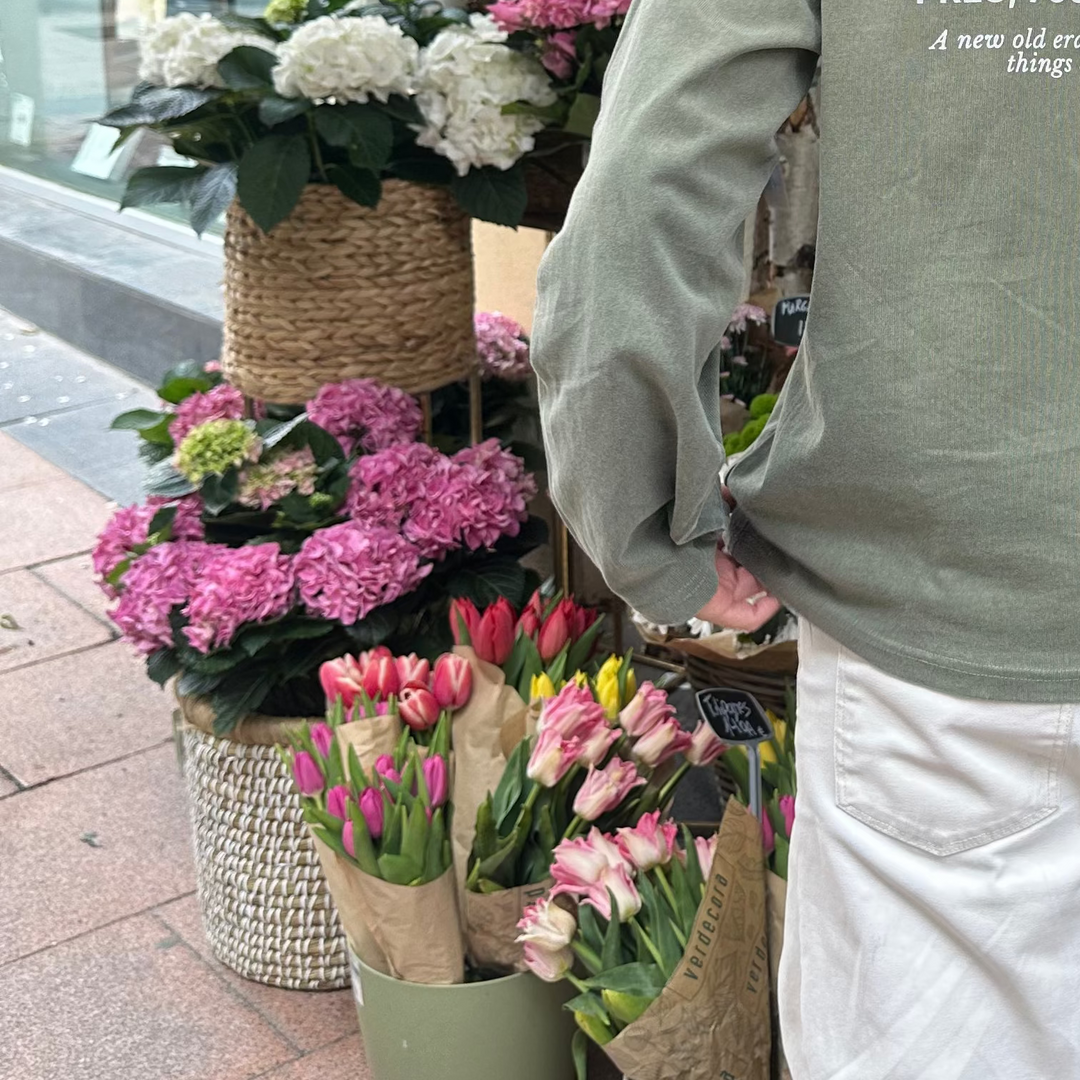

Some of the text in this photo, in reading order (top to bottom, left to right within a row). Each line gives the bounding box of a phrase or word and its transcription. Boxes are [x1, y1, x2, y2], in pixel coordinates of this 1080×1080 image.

[928, 28, 948, 51] A
[957, 34, 1005, 50] new
[1013, 27, 1047, 50] old
[1007, 50, 1073, 79] things
[684, 873, 728, 980] verdecora
